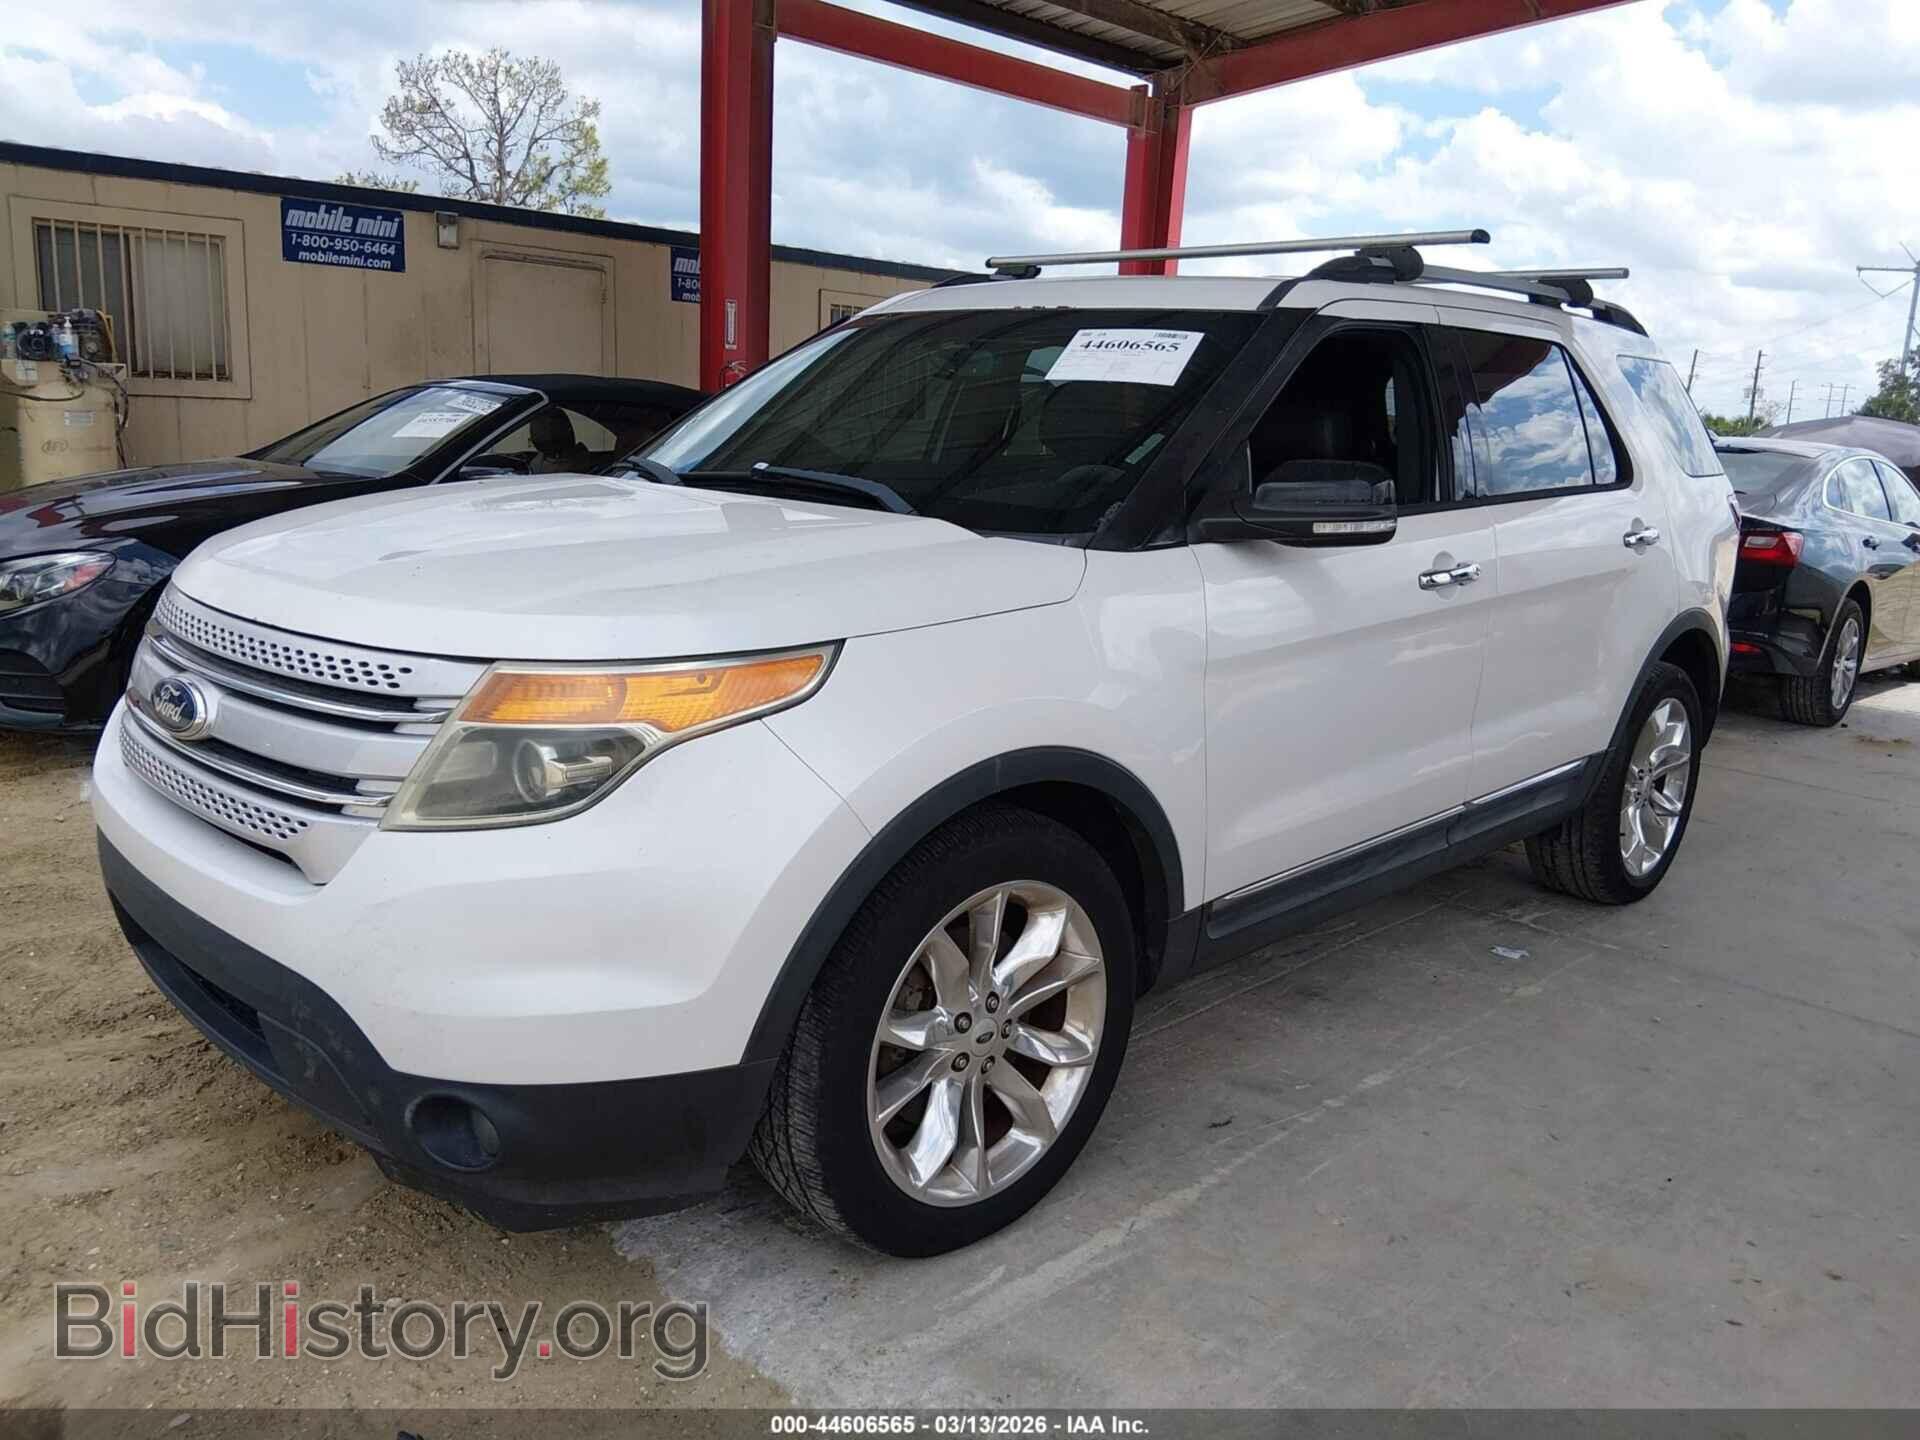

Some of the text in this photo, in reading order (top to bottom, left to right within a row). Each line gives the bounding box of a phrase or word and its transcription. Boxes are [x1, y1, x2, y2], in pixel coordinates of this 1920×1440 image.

[285, 204, 400, 238] mobile mini
[291, 233, 396, 256] 1-800-950-6464
[298, 250, 391, 269] mobilemini.com
[1080, 339, 1182, 353] 44606565
[155, 684, 187, 722] Ford
